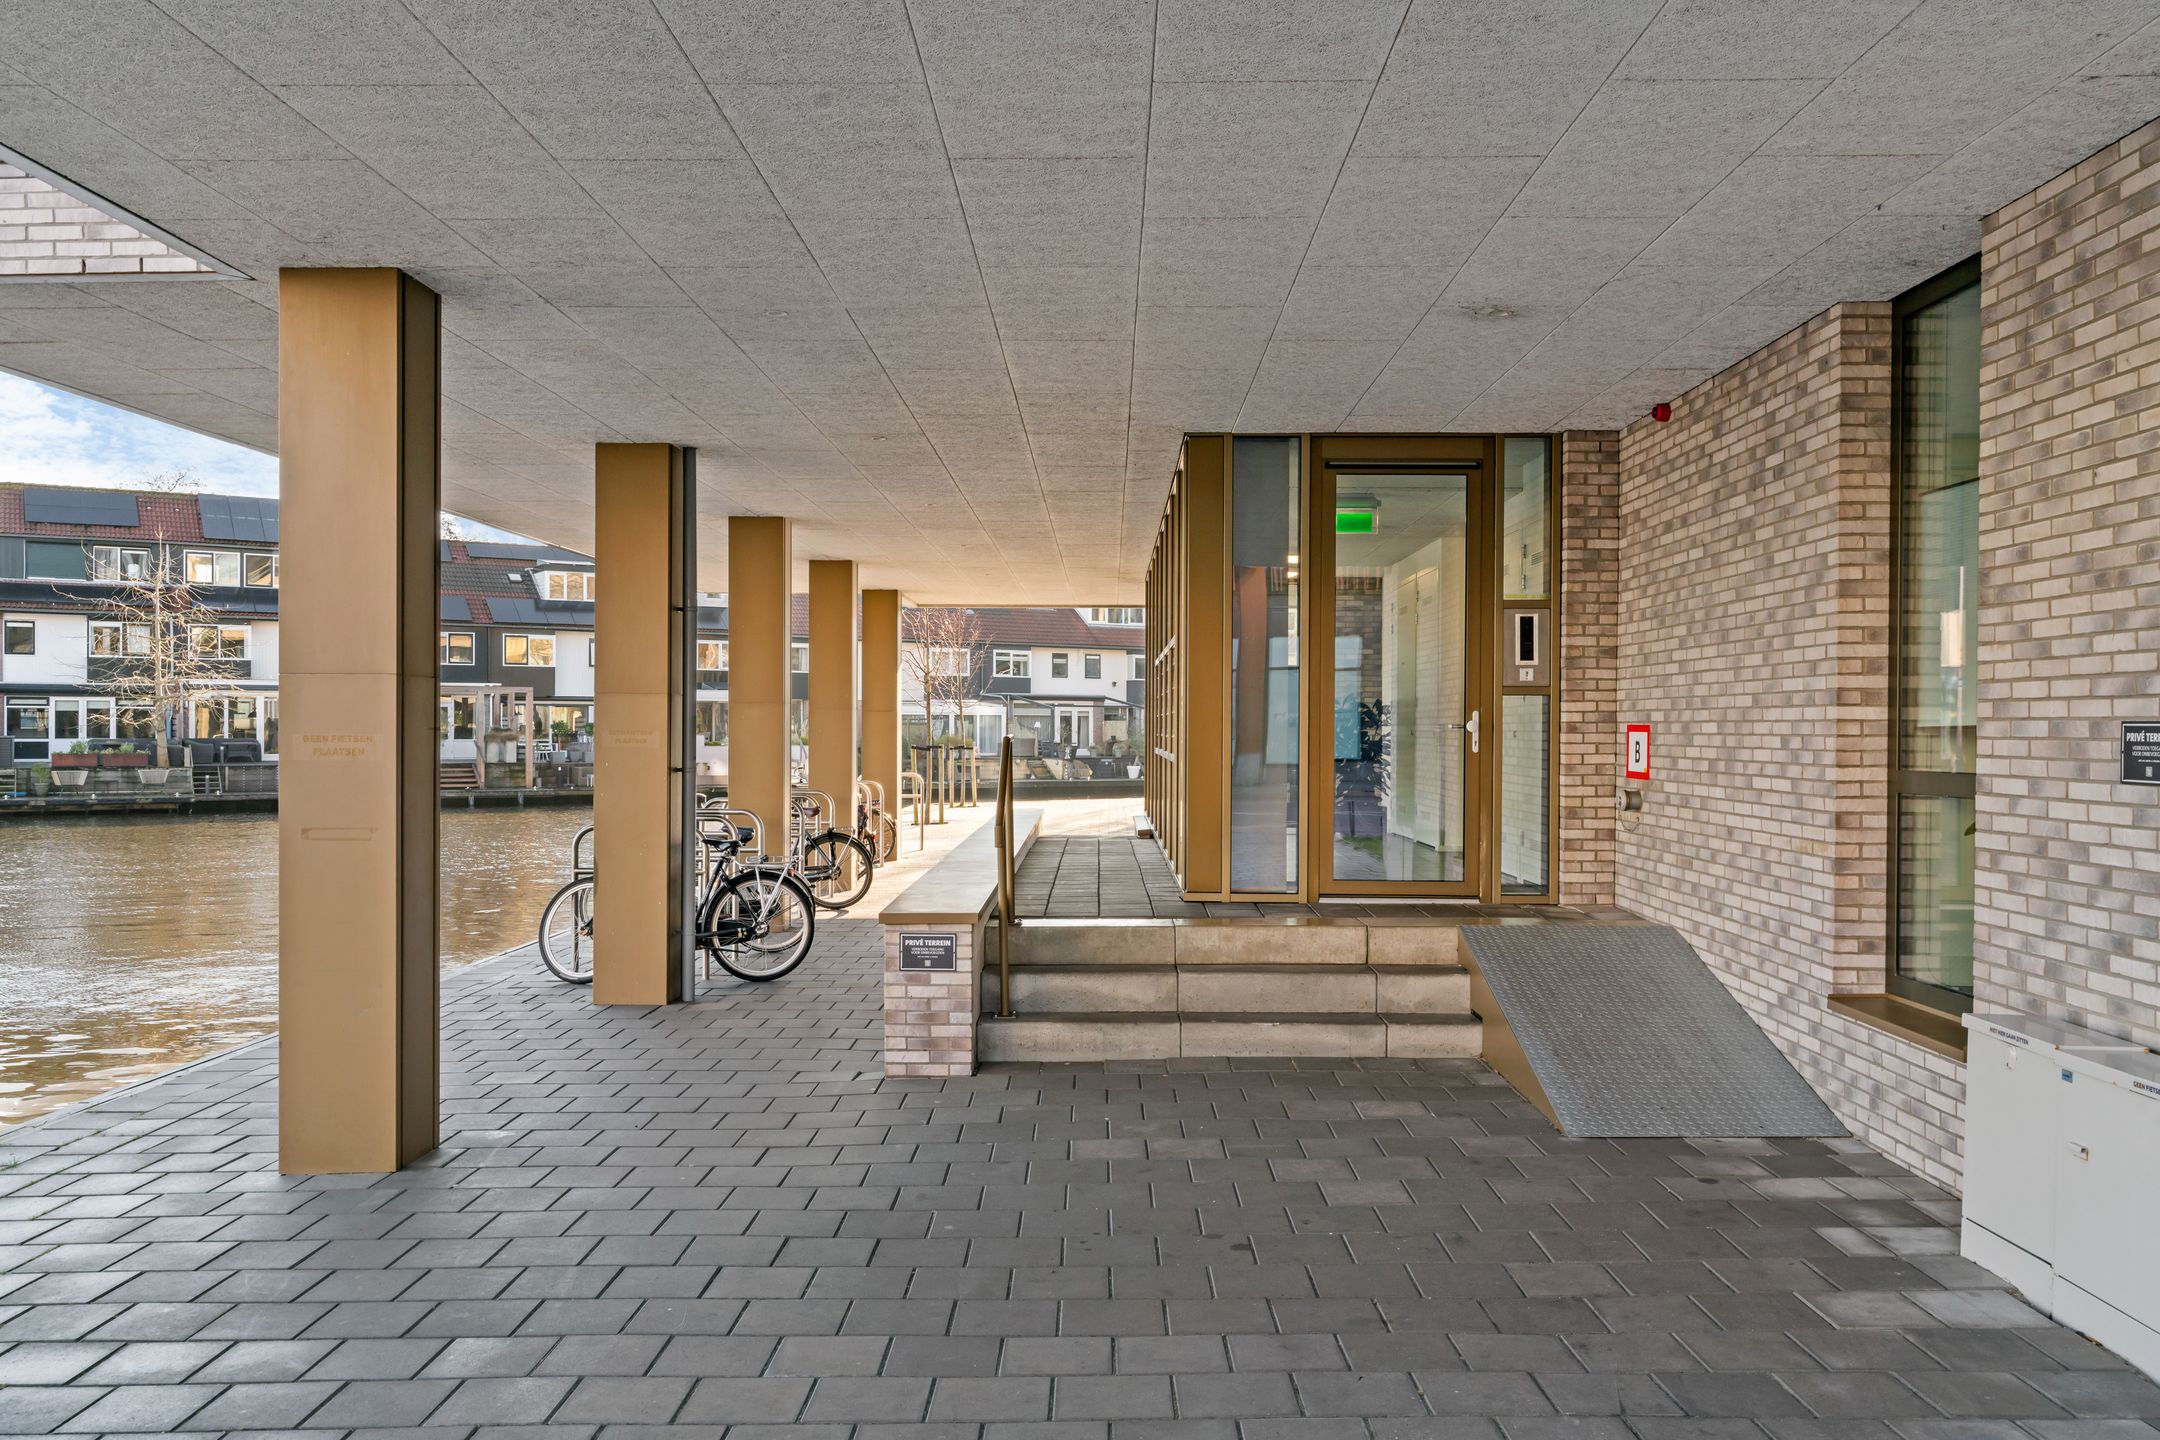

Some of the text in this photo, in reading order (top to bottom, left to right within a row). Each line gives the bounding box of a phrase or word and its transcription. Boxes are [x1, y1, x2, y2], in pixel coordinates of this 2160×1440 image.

[303, 735, 329, 743] GEEN
[2126, 730, 2144, 742] PRIVÉ
[313, 747, 365, 756] PLAATSEN
[1635, 741, 1641, 763] B
[2016, 1036, 2029, 1045] ZITTEN
[2133, 1081, 2145, 1090] GEEN
